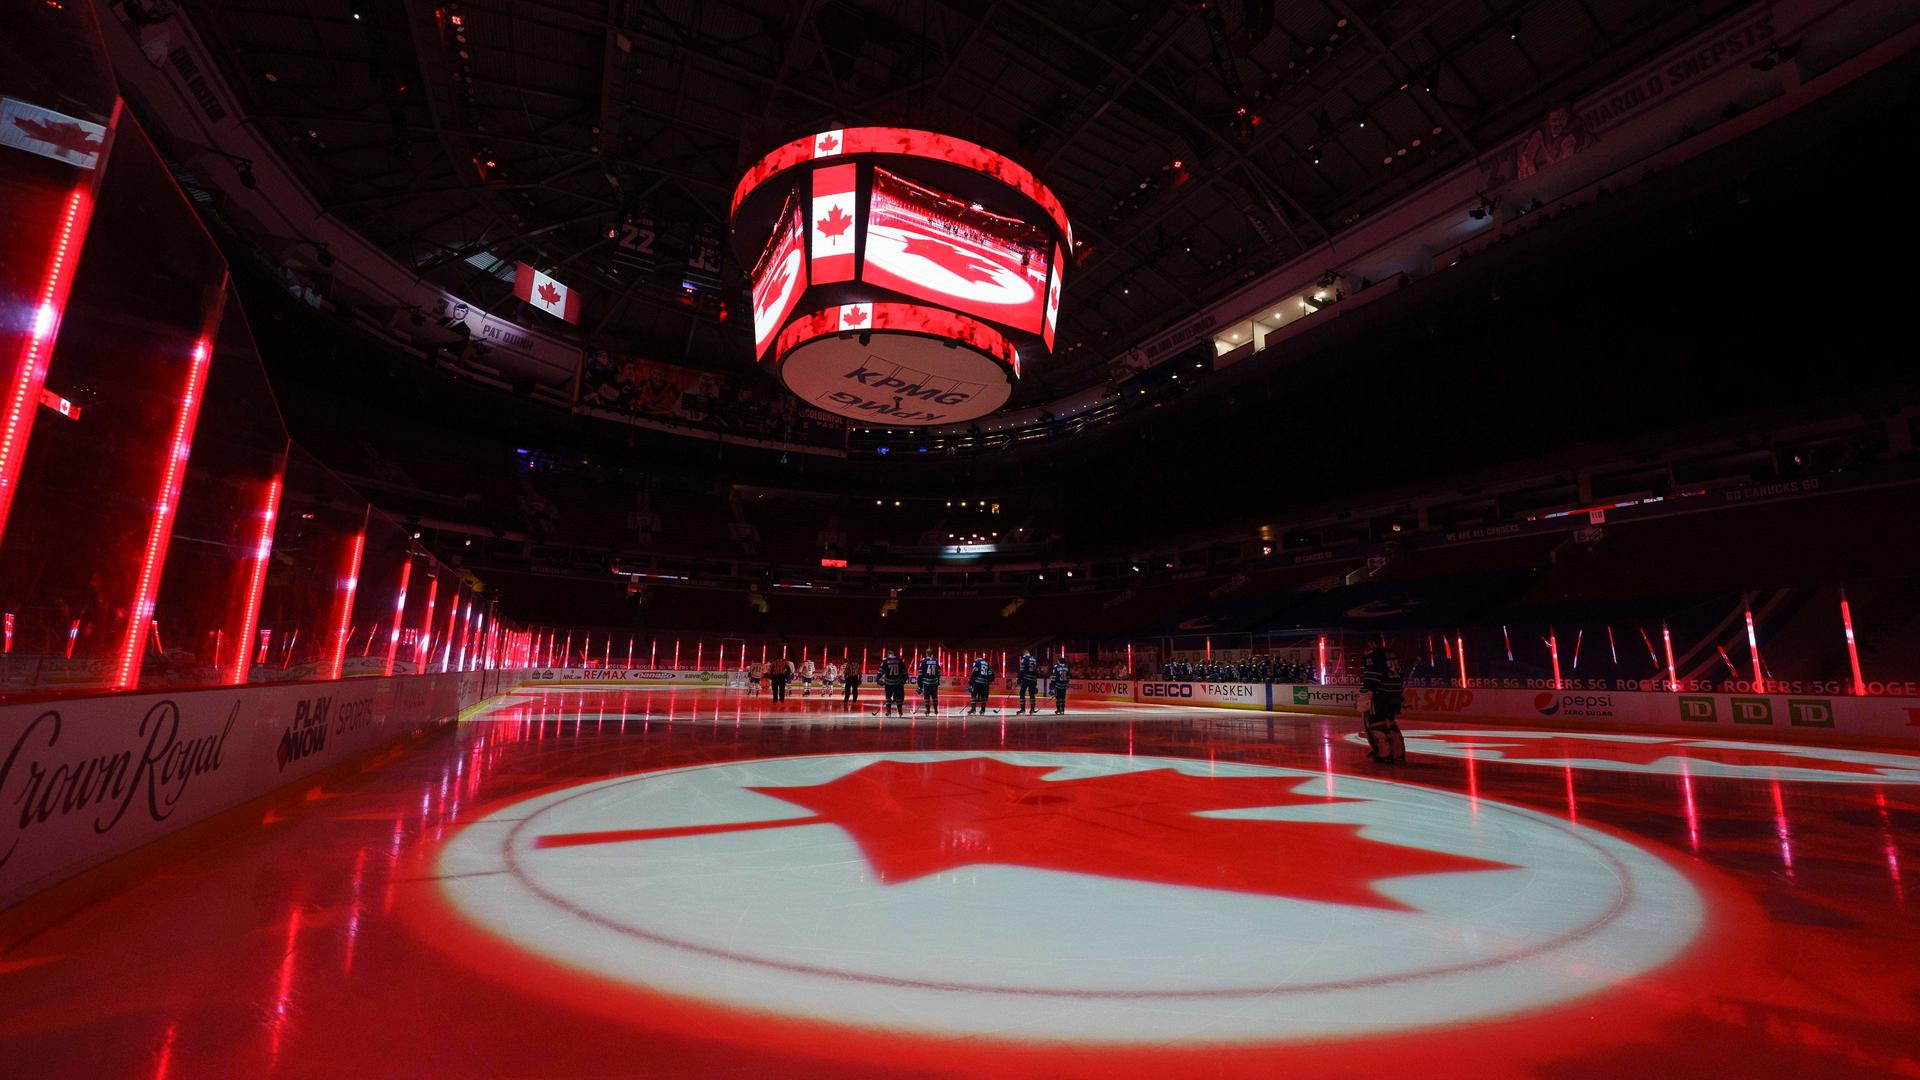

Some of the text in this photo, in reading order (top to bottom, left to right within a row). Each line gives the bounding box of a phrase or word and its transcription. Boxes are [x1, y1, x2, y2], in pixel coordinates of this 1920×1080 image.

[619, 223, 656, 255] 22
[482, 325, 502, 340] PAT
[844, 367, 970, 405] KPMG
[1744, 481, 1799, 498] CANUCKS
[583, 670, 627, 680] RE/MAX
[1326, 677, 1360, 686] ROGERS
[1088, 682, 1128, 694] DISCOVER
[1142, 683, 1193, 698] GEICO
[1208, 684, 1253, 697] FASKEN
[1451, 677, 1519, 689] ROGERS 5G
[1527, 679, 1607, 690] ROGERS 5G
[1616, 679, 1713, 692] ROGERS 5G
[1724, 680, 1840, 694] ROGERS 5G
[1423, 688, 1473, 712] SKIP
[1562, 694, 1612, 707] pepsi
[293, 696, 333, 731] PLAY
[336, 698, 374, 735] SPORTS
[1683, 701, 1712, 717] TD
[1735, 702, 1768, 720] TD
[1793, 703, 1829, 722] TD
[288, 723, 328, 763] NOW
[95, 700, 241, 834] Royal
